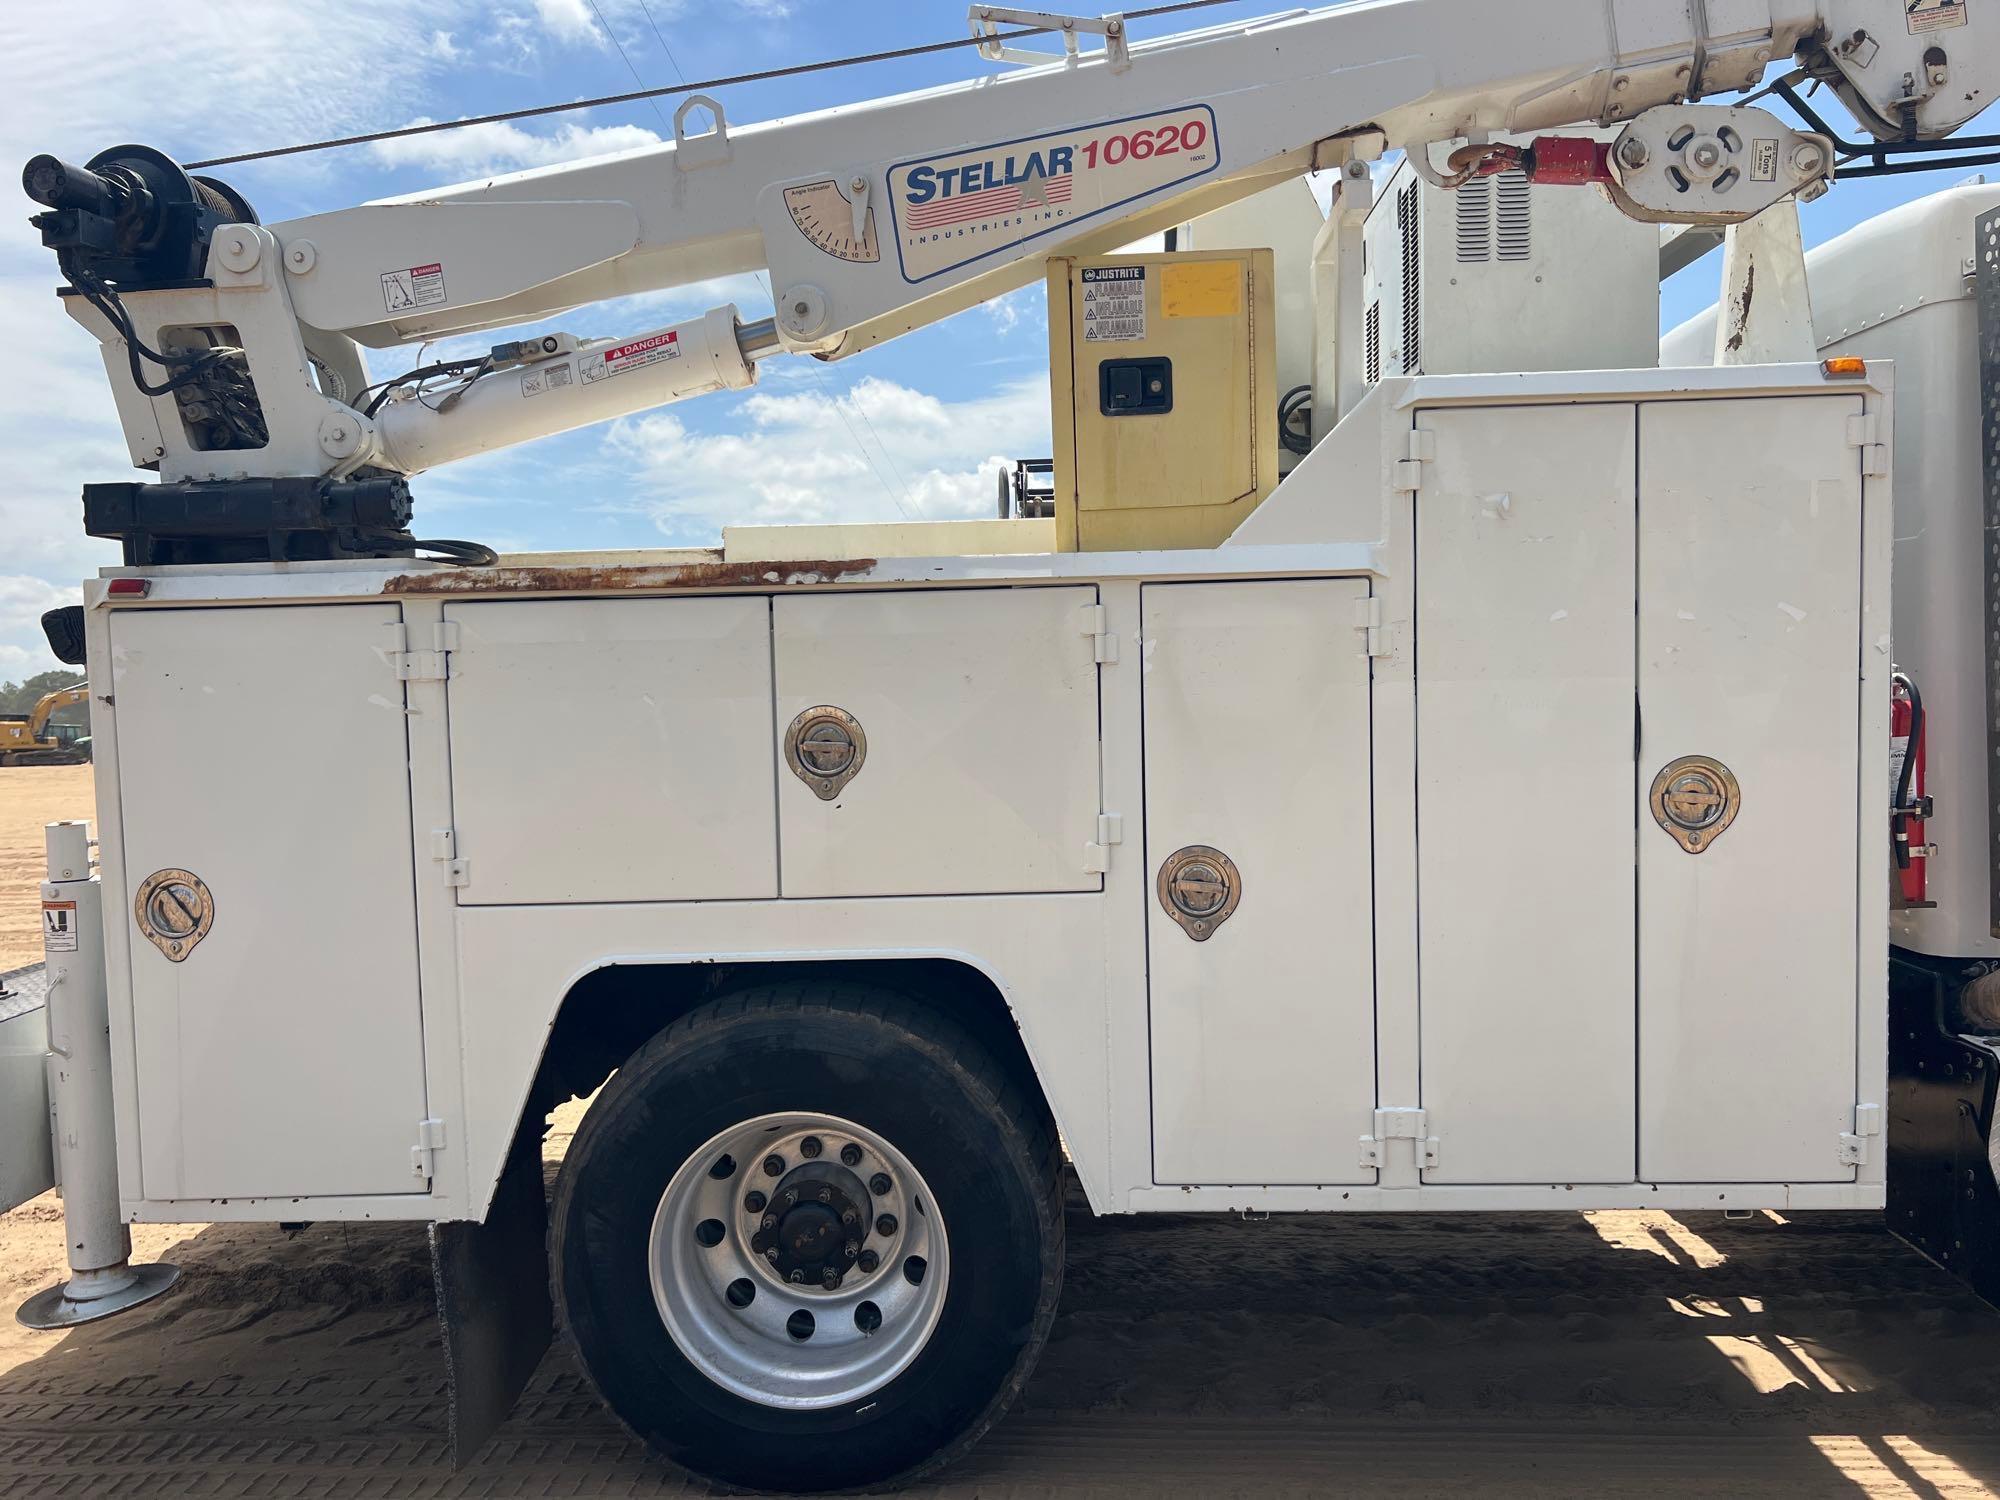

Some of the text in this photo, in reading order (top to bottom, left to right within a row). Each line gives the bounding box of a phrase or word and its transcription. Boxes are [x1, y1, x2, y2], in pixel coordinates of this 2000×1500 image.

[1081, 120, 1207, 170] 10620
[1762, 153, 1771, 174] Tons
[906, 146, 1074, 204] STELLAR
[791, 184, 831, 196] Angle Indicator
[909, 208, 1072, 246] INDUSTRIES INC.
[840, 250, 848, 258] 20
[418, 265, 440, 274] DANGER
[1096, 268, 1140, 279] JUSTRITE
[1095, 281, 1142, 297] FLAMMABLE
[624, 334, 670, 355] DANGER
